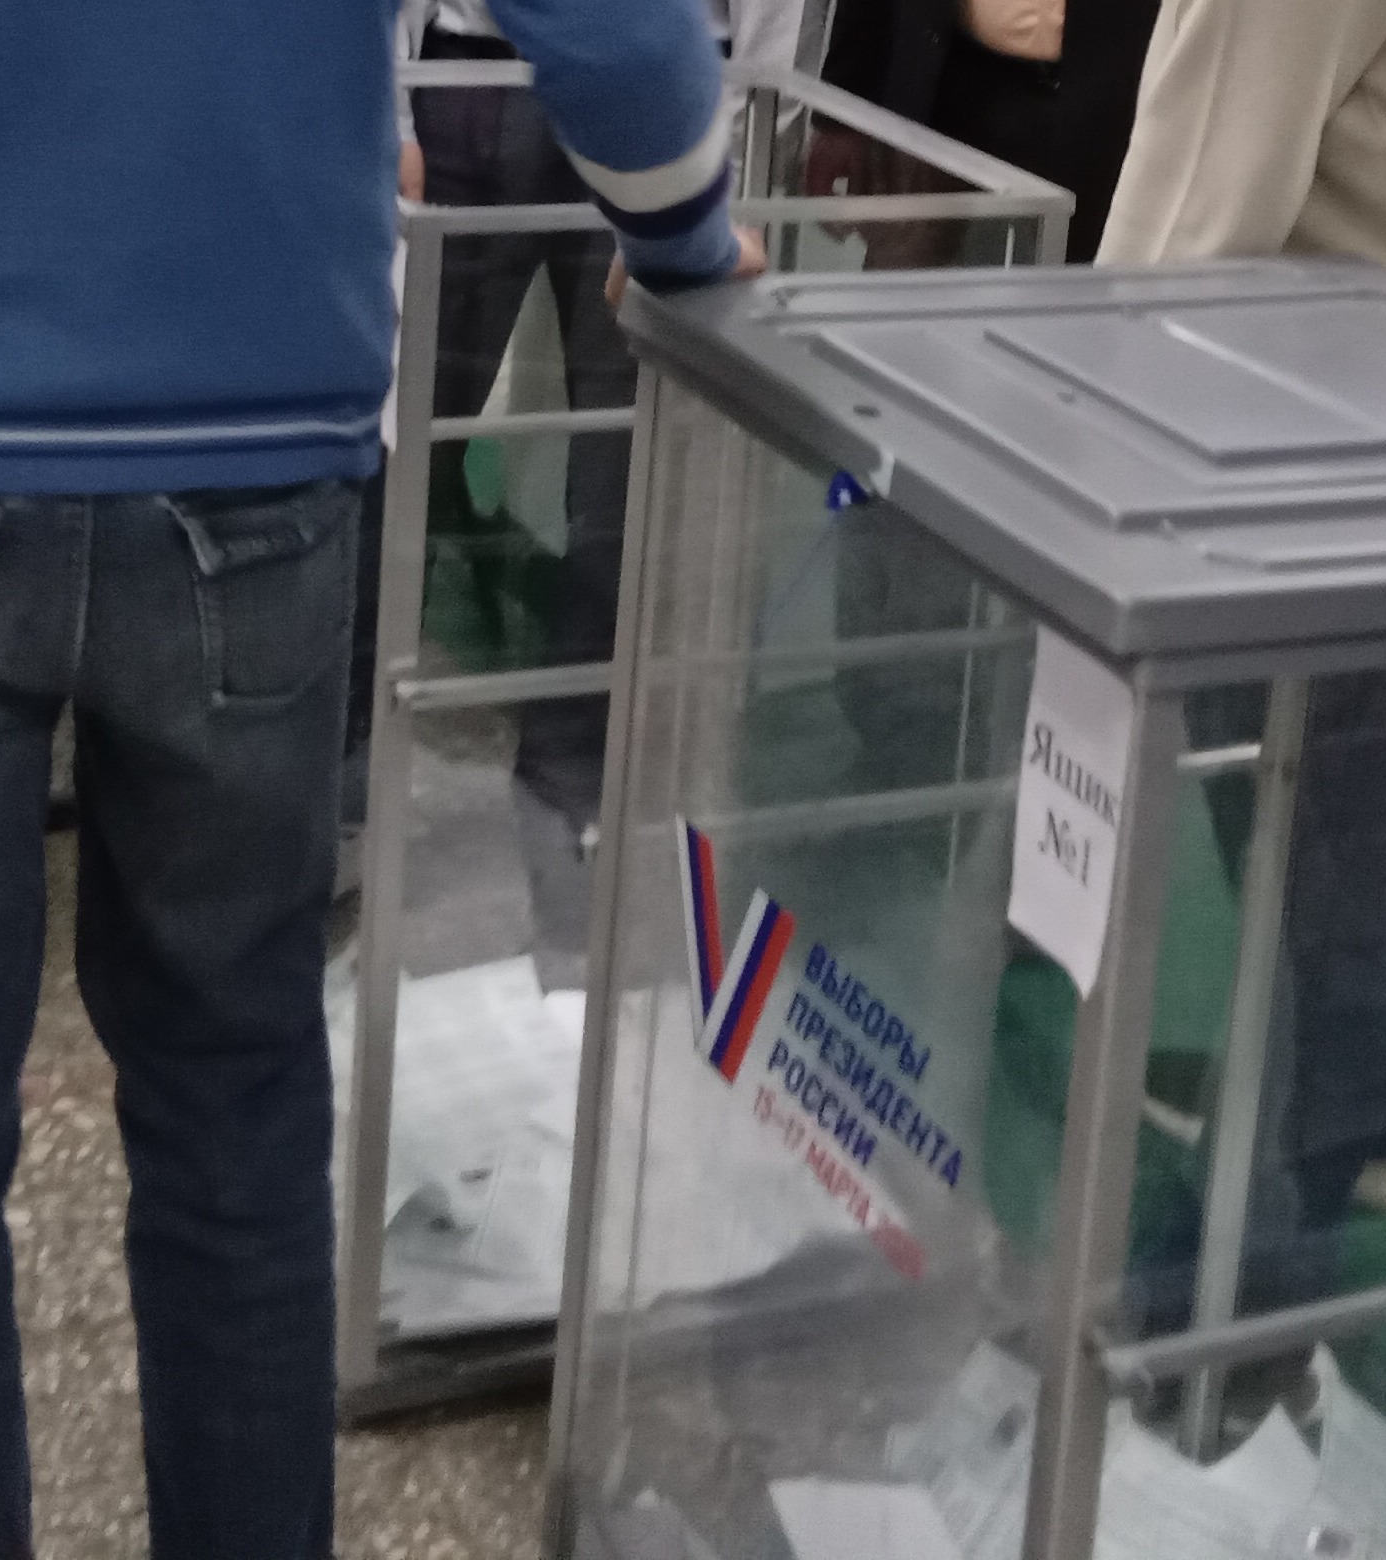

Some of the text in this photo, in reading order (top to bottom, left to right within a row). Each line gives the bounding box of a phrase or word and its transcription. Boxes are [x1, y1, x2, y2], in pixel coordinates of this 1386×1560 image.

[1029, 723, 1115, 827] Ящик
[803, 942, 931, 1083] ВЫБОРЫ
[767, 1040, 878, 1169] РОССИИ
[785, 991, 963, 1189] ПРЕЗИДЕНТА
